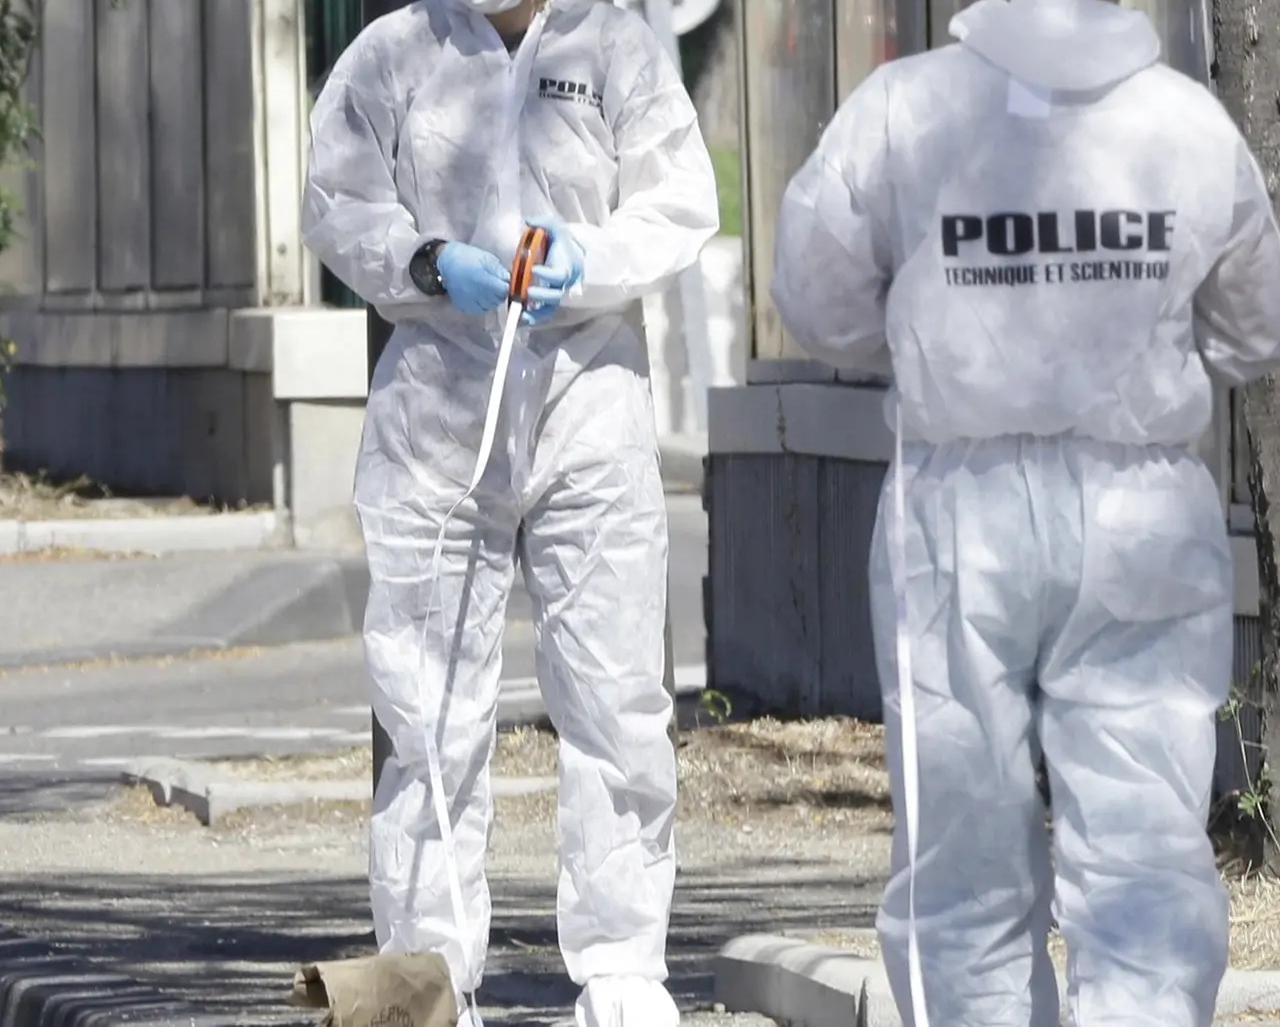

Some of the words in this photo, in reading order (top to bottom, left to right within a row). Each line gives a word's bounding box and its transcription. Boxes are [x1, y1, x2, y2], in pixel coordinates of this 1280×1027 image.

[941, 209, 1176, 257] POLICE
[945, 264, 1038, 287] TECHNIQUE
[1045, 264, 1065, 283] ET
